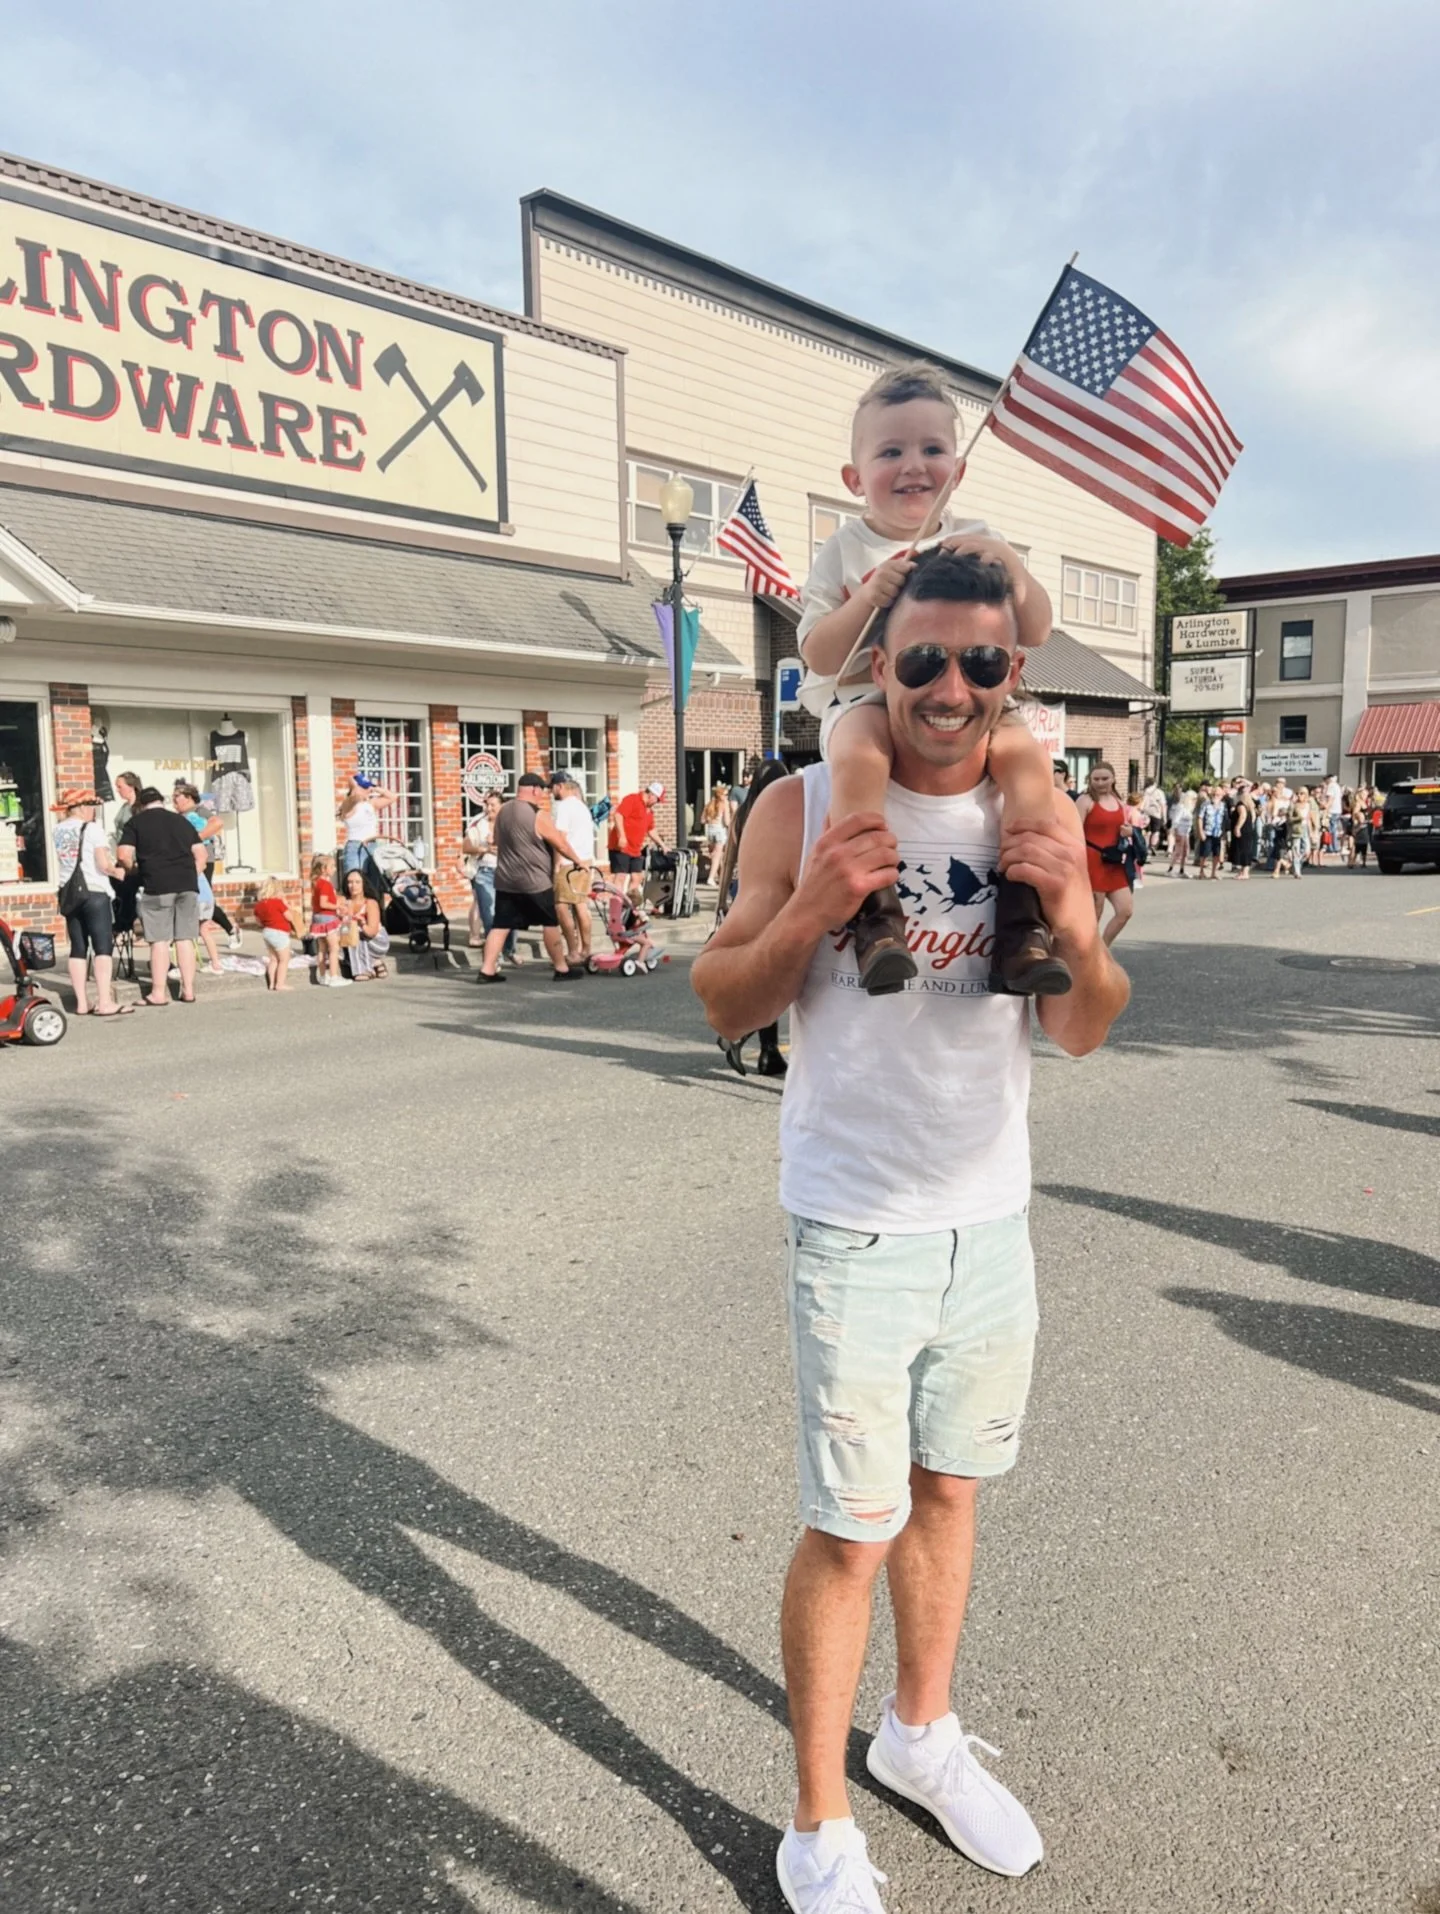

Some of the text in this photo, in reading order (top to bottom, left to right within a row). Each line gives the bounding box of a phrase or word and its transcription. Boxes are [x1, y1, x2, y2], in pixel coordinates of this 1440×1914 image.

[0, 236, 364, 391] INGTON
[1176, 617, 1230, 630] Arlington
[1179, 628, 1237, 640] Hardware
[1185, 638, 1240, 649] & Lumber
[1190, 666, 1216, 676] SUPER
[1184, 675, 1224, 685] SATURDAY
[154, 759, 187, 771] PAINT
[919, 979, 956, 994] AND
[960, 982, 990, 995] LUM
